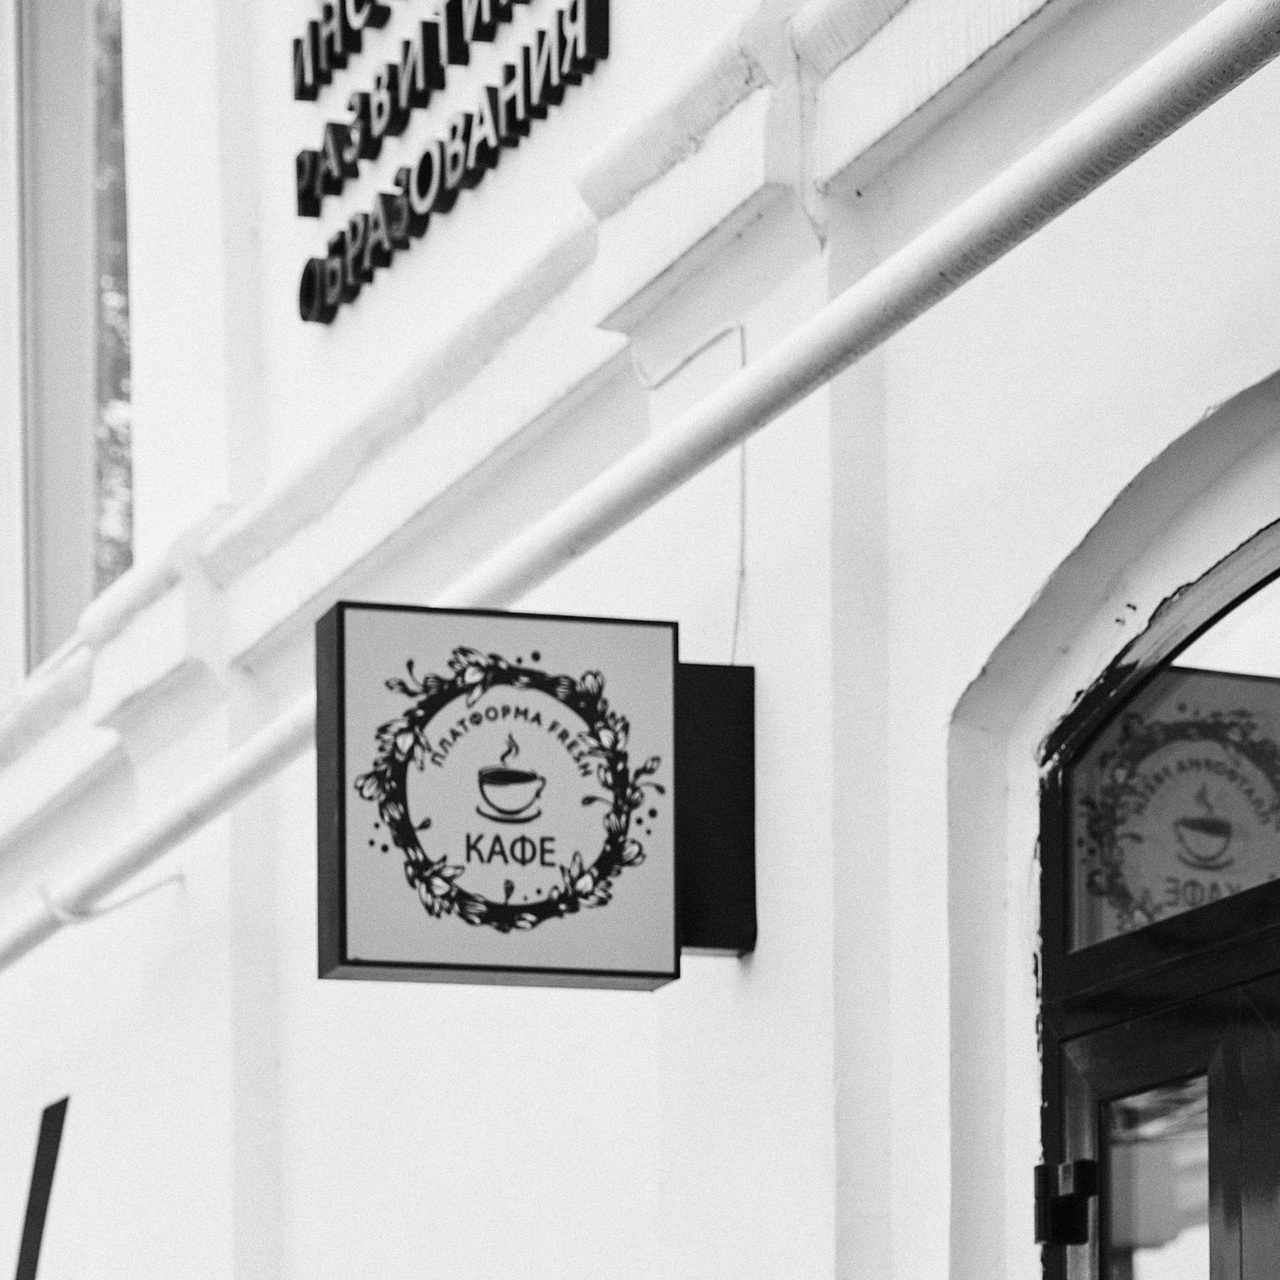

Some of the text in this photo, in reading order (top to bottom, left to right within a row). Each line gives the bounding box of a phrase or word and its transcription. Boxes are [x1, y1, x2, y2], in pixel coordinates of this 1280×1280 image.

[298, 0, 609, 324] ОБРАЗОВАНИЯ
[430, 703, 593, 778] ПЛАТФОРМА FRESH
[465, 832, 557, 867] КАФЕ
